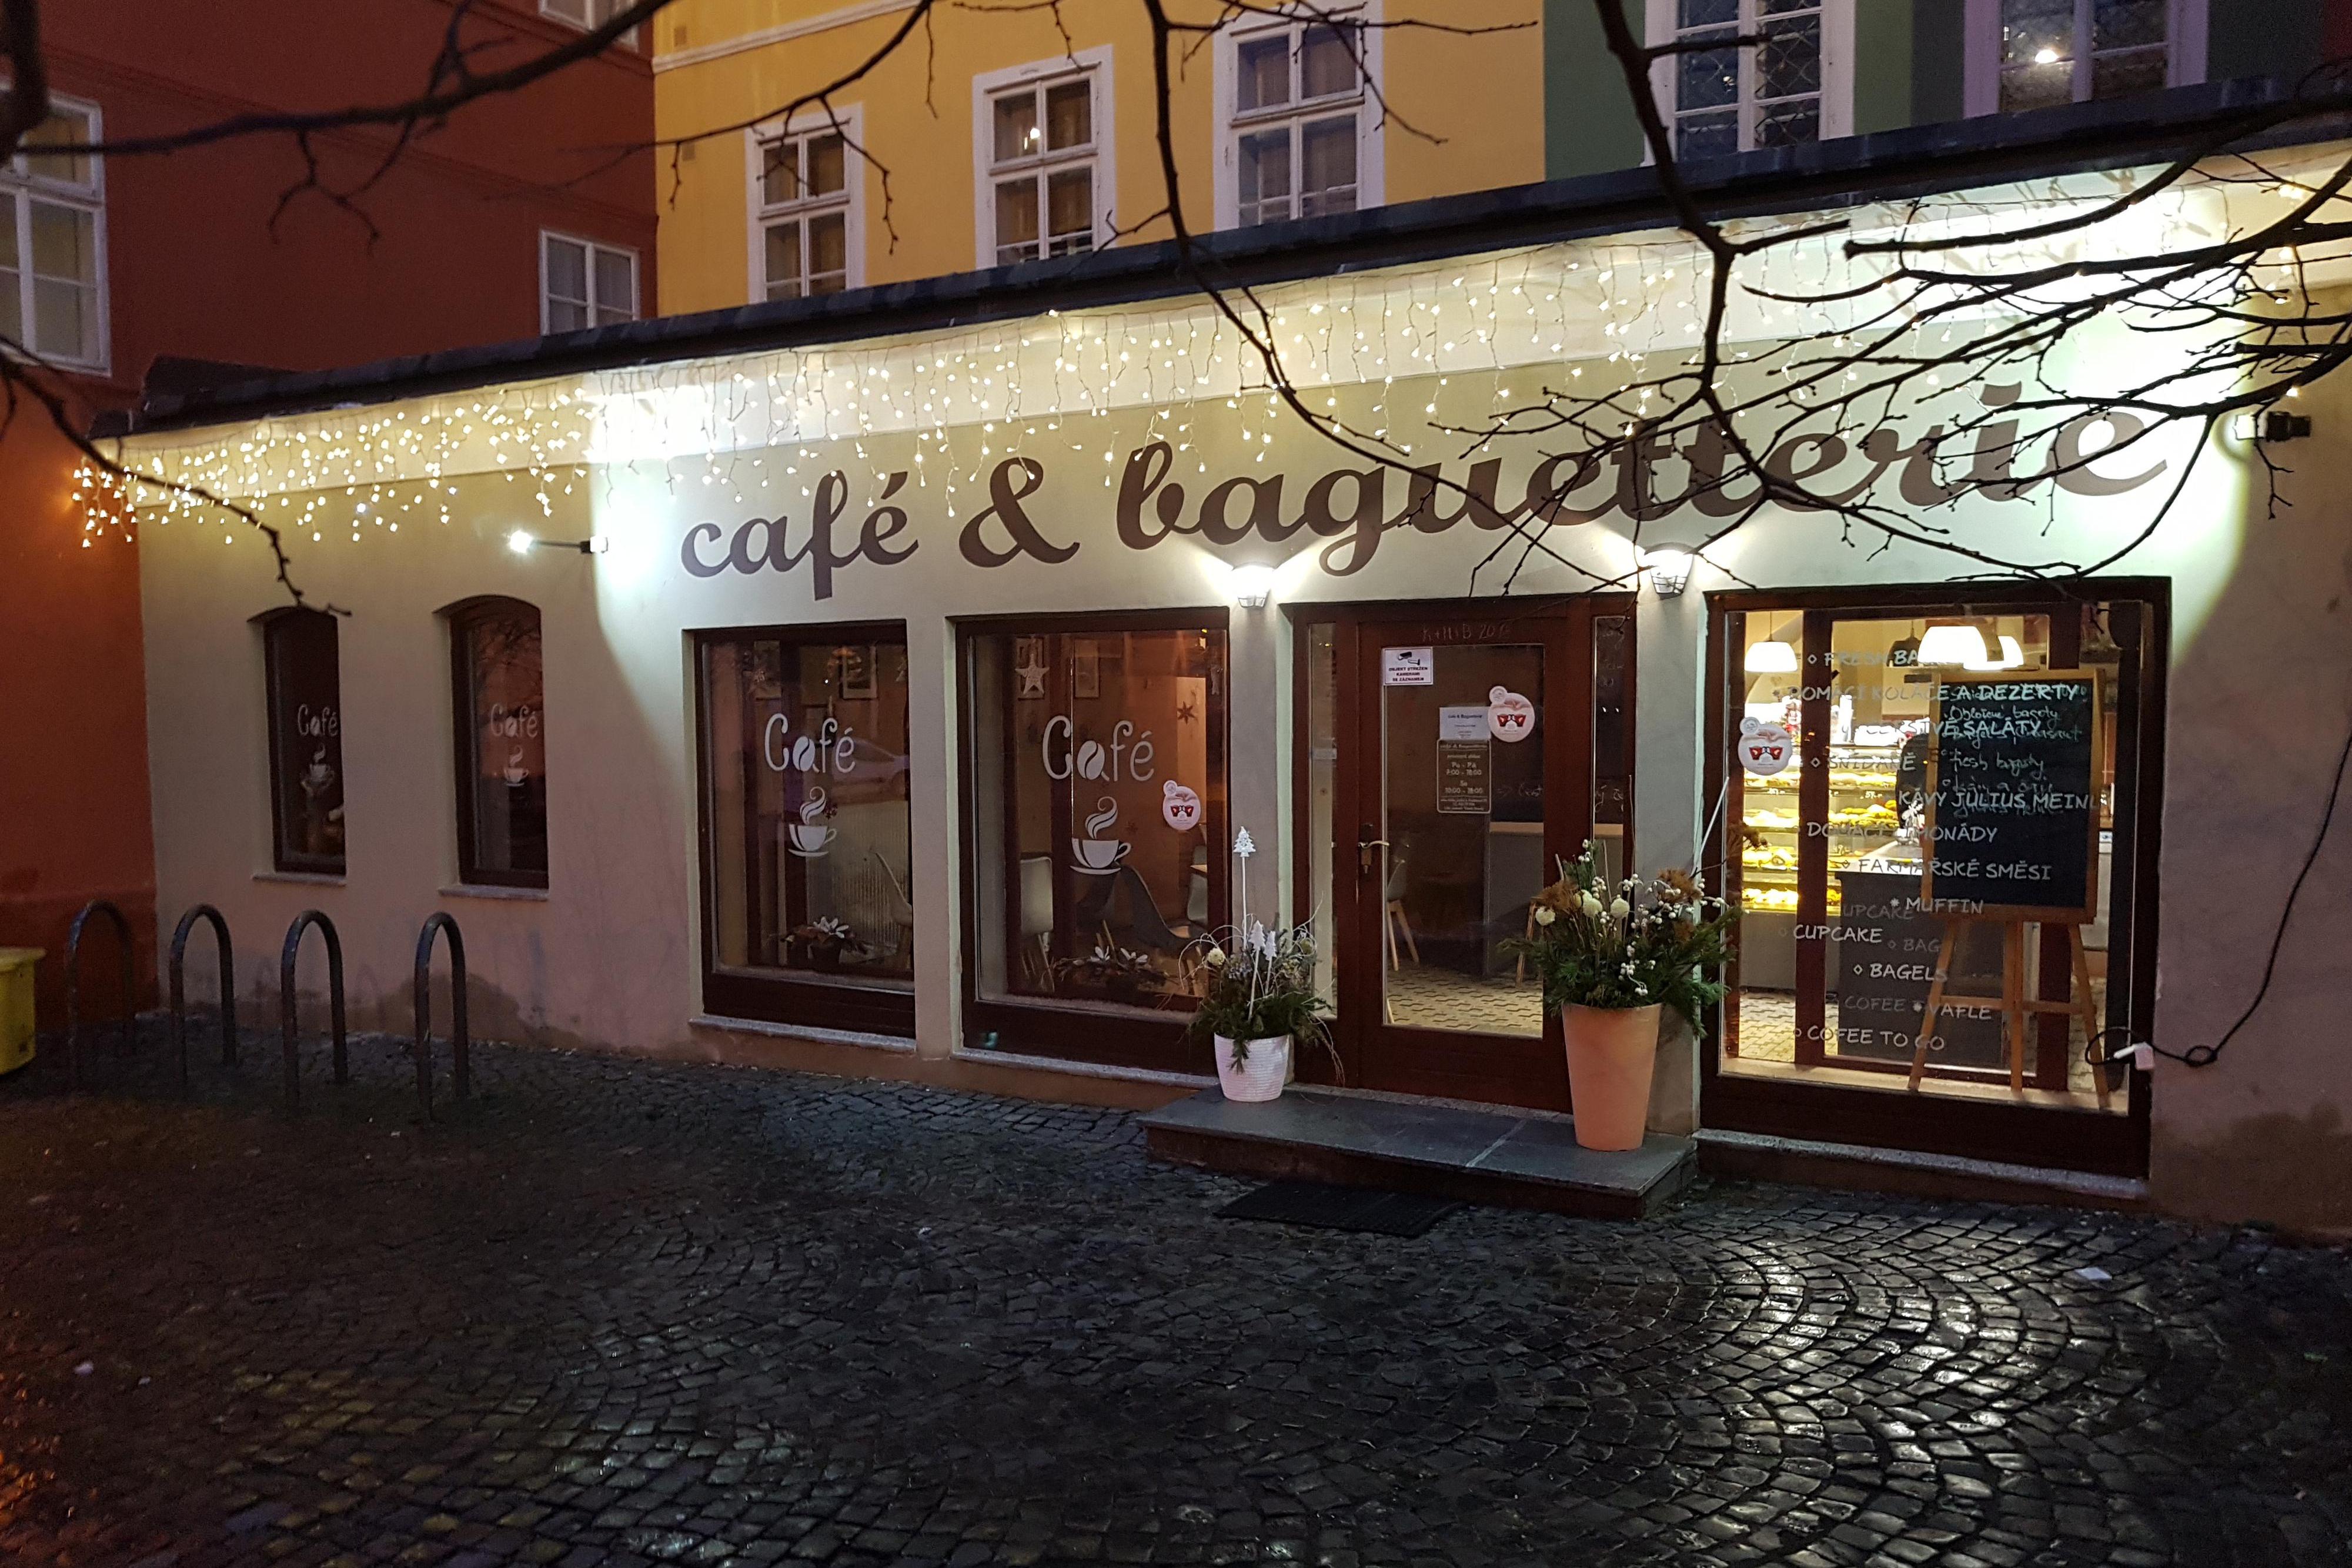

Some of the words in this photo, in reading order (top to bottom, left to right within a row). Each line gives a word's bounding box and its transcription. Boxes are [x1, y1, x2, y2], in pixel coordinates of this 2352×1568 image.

[680, 469, 920, 601] café
[958, 456, 1080, 567] &
[1115, 381, 2167, 577] baguetterie
[1977, 683, 2080, 701] DEZERTY
[297, 704, 338, 737] Café
[490, 703, 538, 738] Café
[764, 713, 855, 774] Café
[1041, 714, 1155, 783] Café
[1899, 787, 1946, 807] KÁVY
[1951, 793, 2026, 809] JULIUS
[1985, 860, 2053, 881] SMĚSI
[1905, 896, 1984, 915] MUFFIN
[1793, 924, 1883, 944] CUPCAKE
[1869, 962, 1947, 983] BAGELS
[1807, 1025, 1873, 1044] COFEE
[1879, 1030, 1909, 1047] TO
[1914, 1034, 1945, 1051] GO
